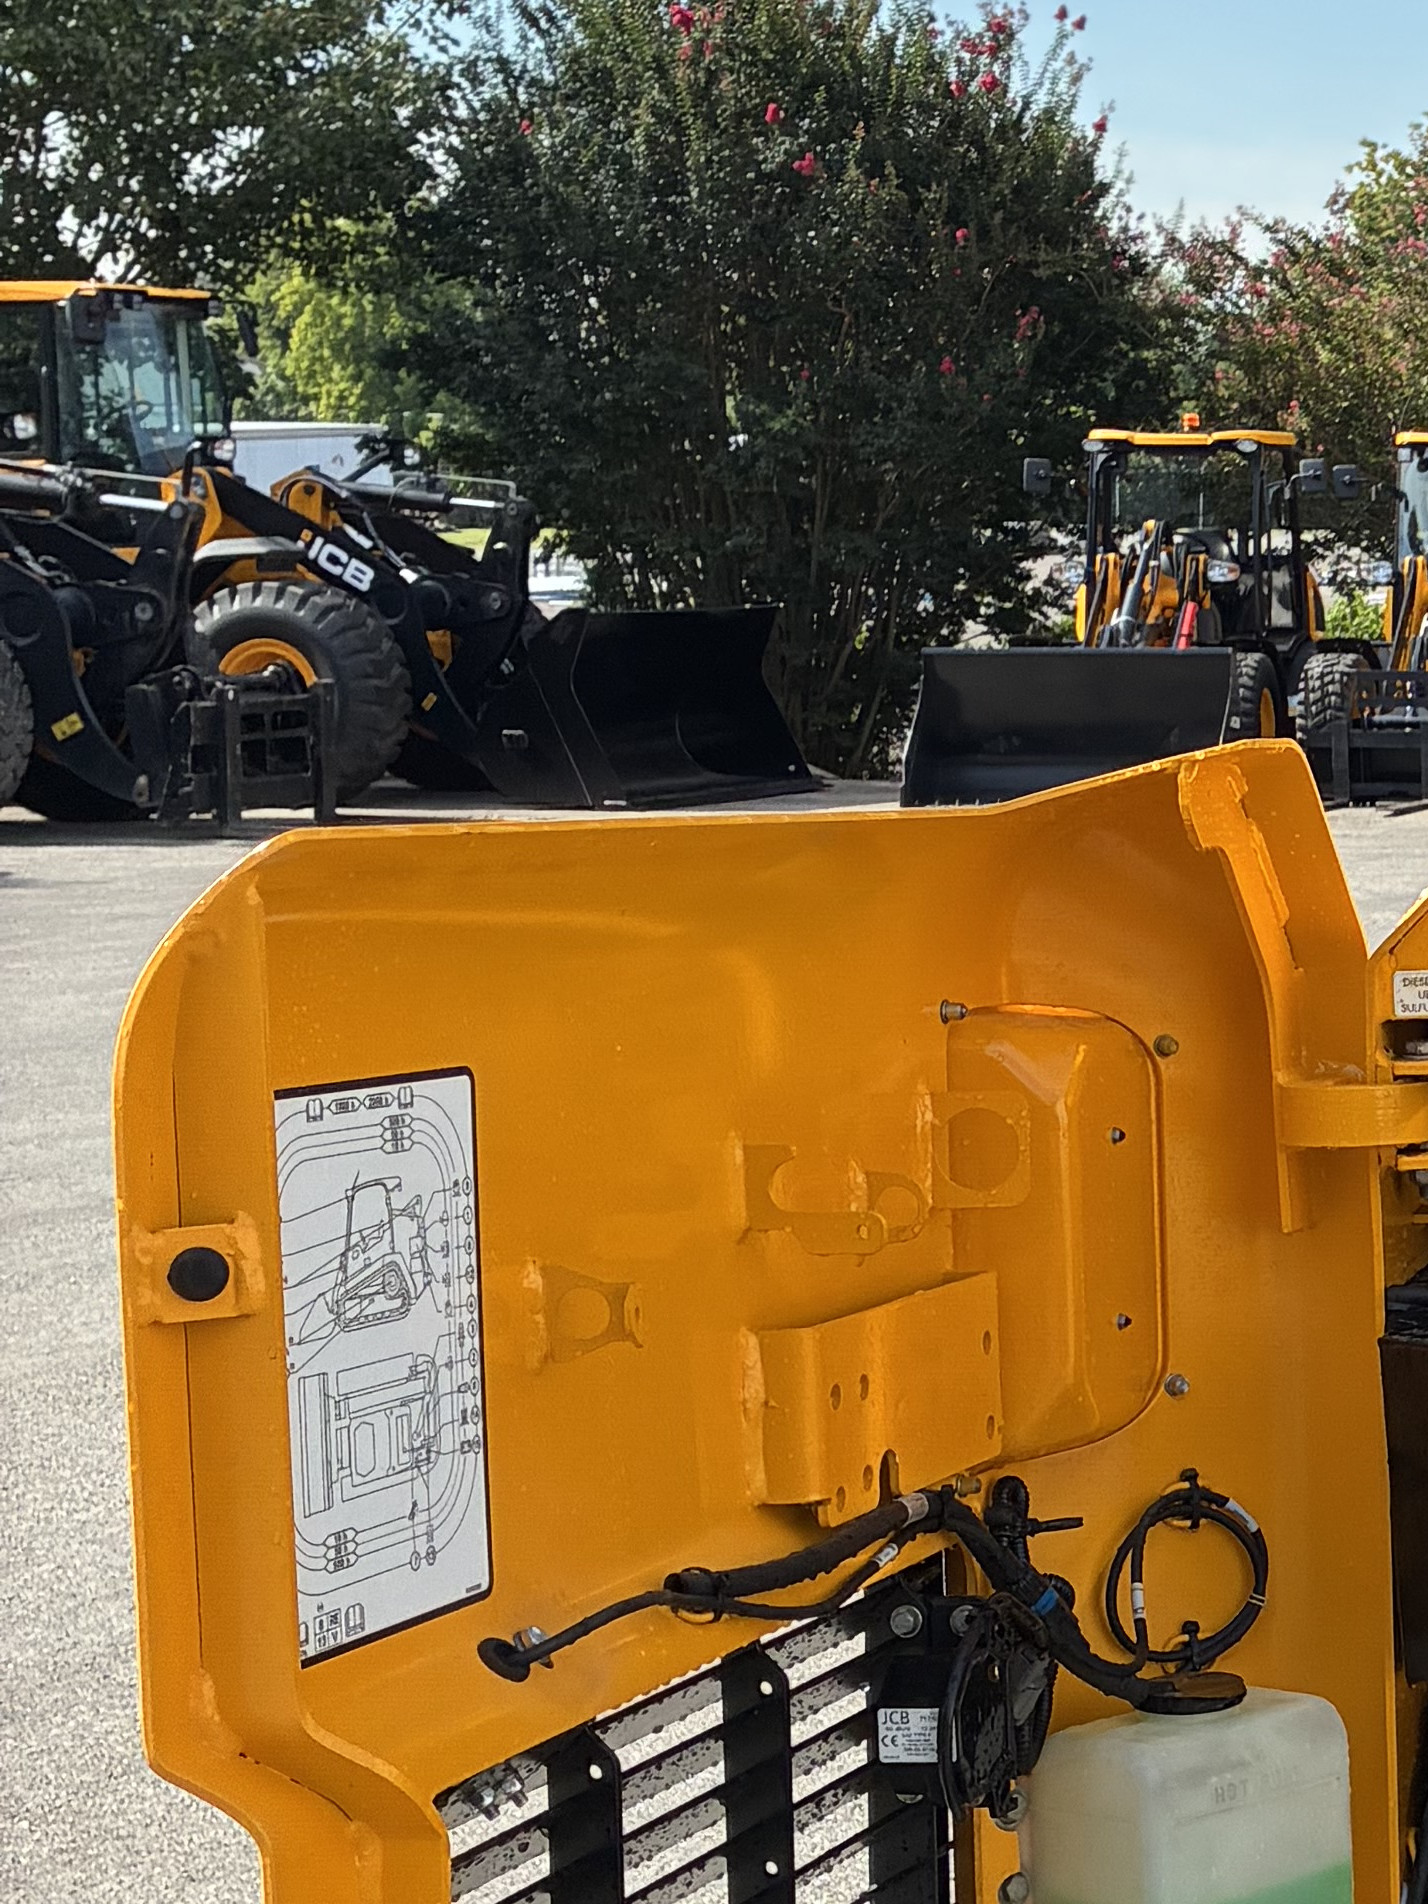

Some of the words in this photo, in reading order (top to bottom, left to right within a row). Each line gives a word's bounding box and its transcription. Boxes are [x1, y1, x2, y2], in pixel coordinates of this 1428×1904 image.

[297, 535, 375, 593] JCB
[881, 1710, 910, 1725] JCB
[1214, 1779, 1249, 1804] HOT
